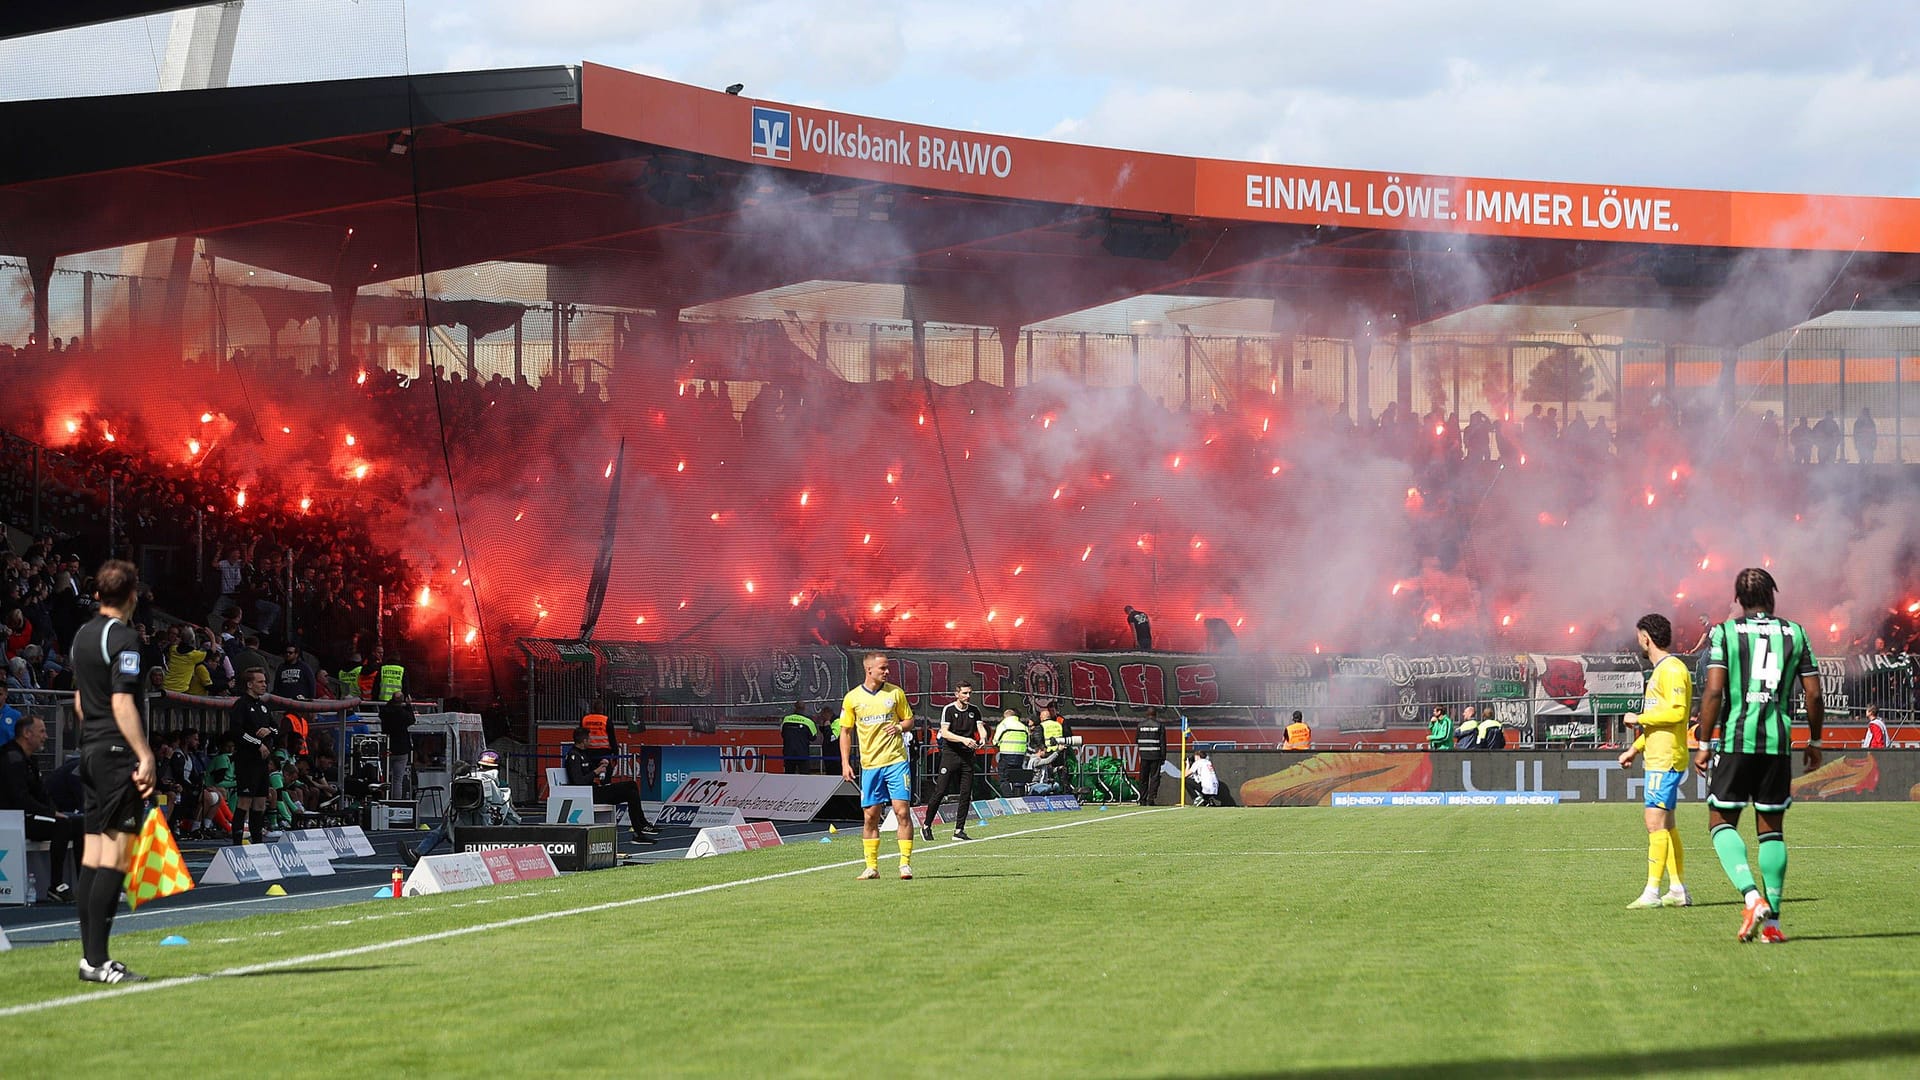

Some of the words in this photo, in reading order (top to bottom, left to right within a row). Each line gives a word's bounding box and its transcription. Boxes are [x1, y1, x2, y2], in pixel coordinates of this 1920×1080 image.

[797, 117, 911, 166] Volksbank
[918, 136, 1012, 178] BRAWO
[1246, 174, 1360, 214] EINMAL
[1367, 176, 1457, 221] LÖWE.
[1466, 190, 1572, 227] IMMER
[1582, 188, 1679, 232] LÖWE.
[1751, 638, 1781, 689] 4
[658, 806, 697, 824] Reese
